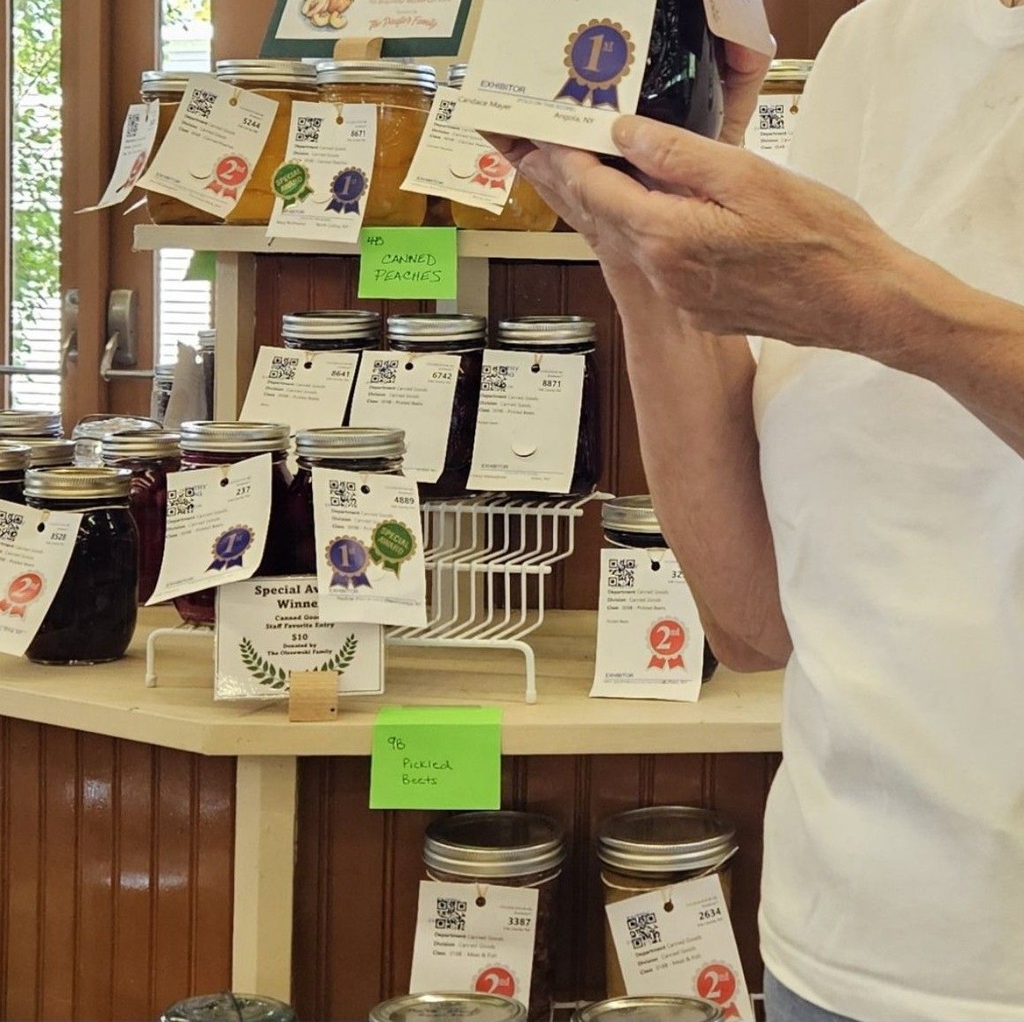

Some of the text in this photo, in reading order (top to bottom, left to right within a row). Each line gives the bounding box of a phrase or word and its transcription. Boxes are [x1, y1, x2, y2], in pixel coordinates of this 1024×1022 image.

[480, 79, 526, 94] EXHIBITOR
[382, 254, 436, 266] CANNED
[375, 269, 441, 282] PEACHES
[432, 372, 452, 380] 6742
[672, 570, 682, 578] 32
[254, 585, 301, 597] Special
[277, 599, 318, 608] Winne
[388, 736, 406, 750] 9B
[402, 758, 453, 770] Pickled
[402, 774, 437, 785] Beets
[699, 907, 721, 920] 2634
[508, 917, 531, 926] 3387
